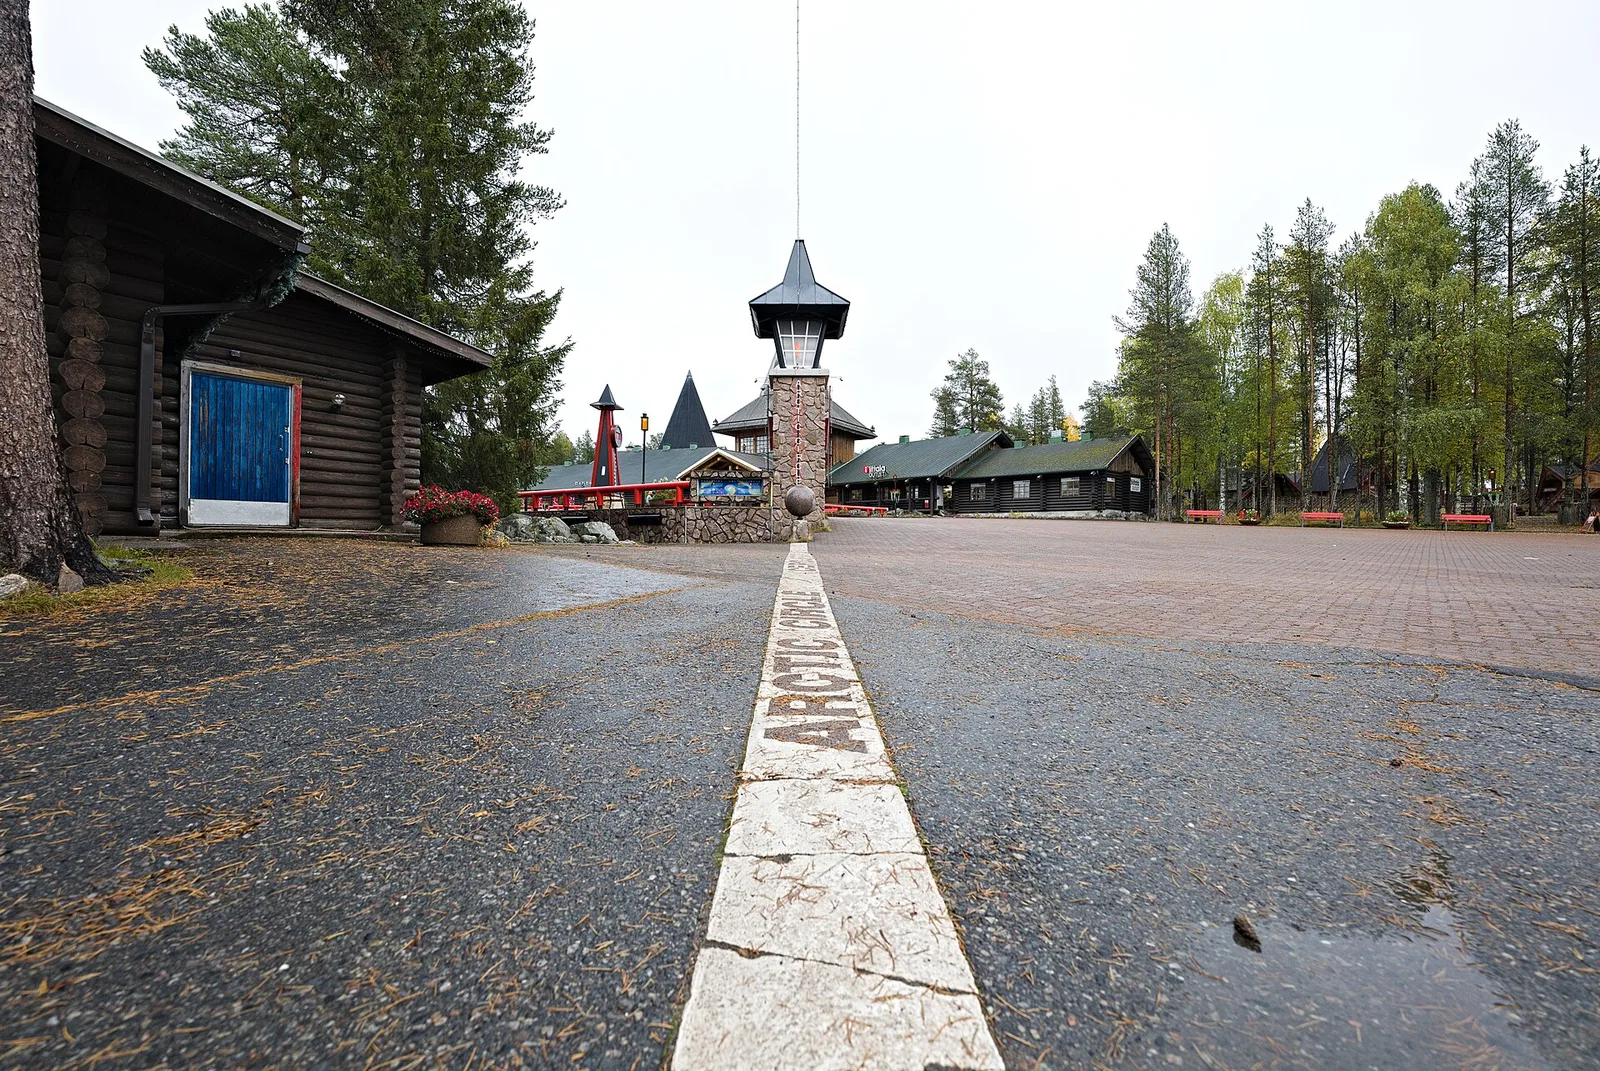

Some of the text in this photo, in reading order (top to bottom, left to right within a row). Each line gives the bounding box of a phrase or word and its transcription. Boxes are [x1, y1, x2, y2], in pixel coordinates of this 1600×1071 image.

[795, 379, 803, 485] ARCTIC CIRCLE
[763, 590, 868, 753] ARCTIC CIRCLE
